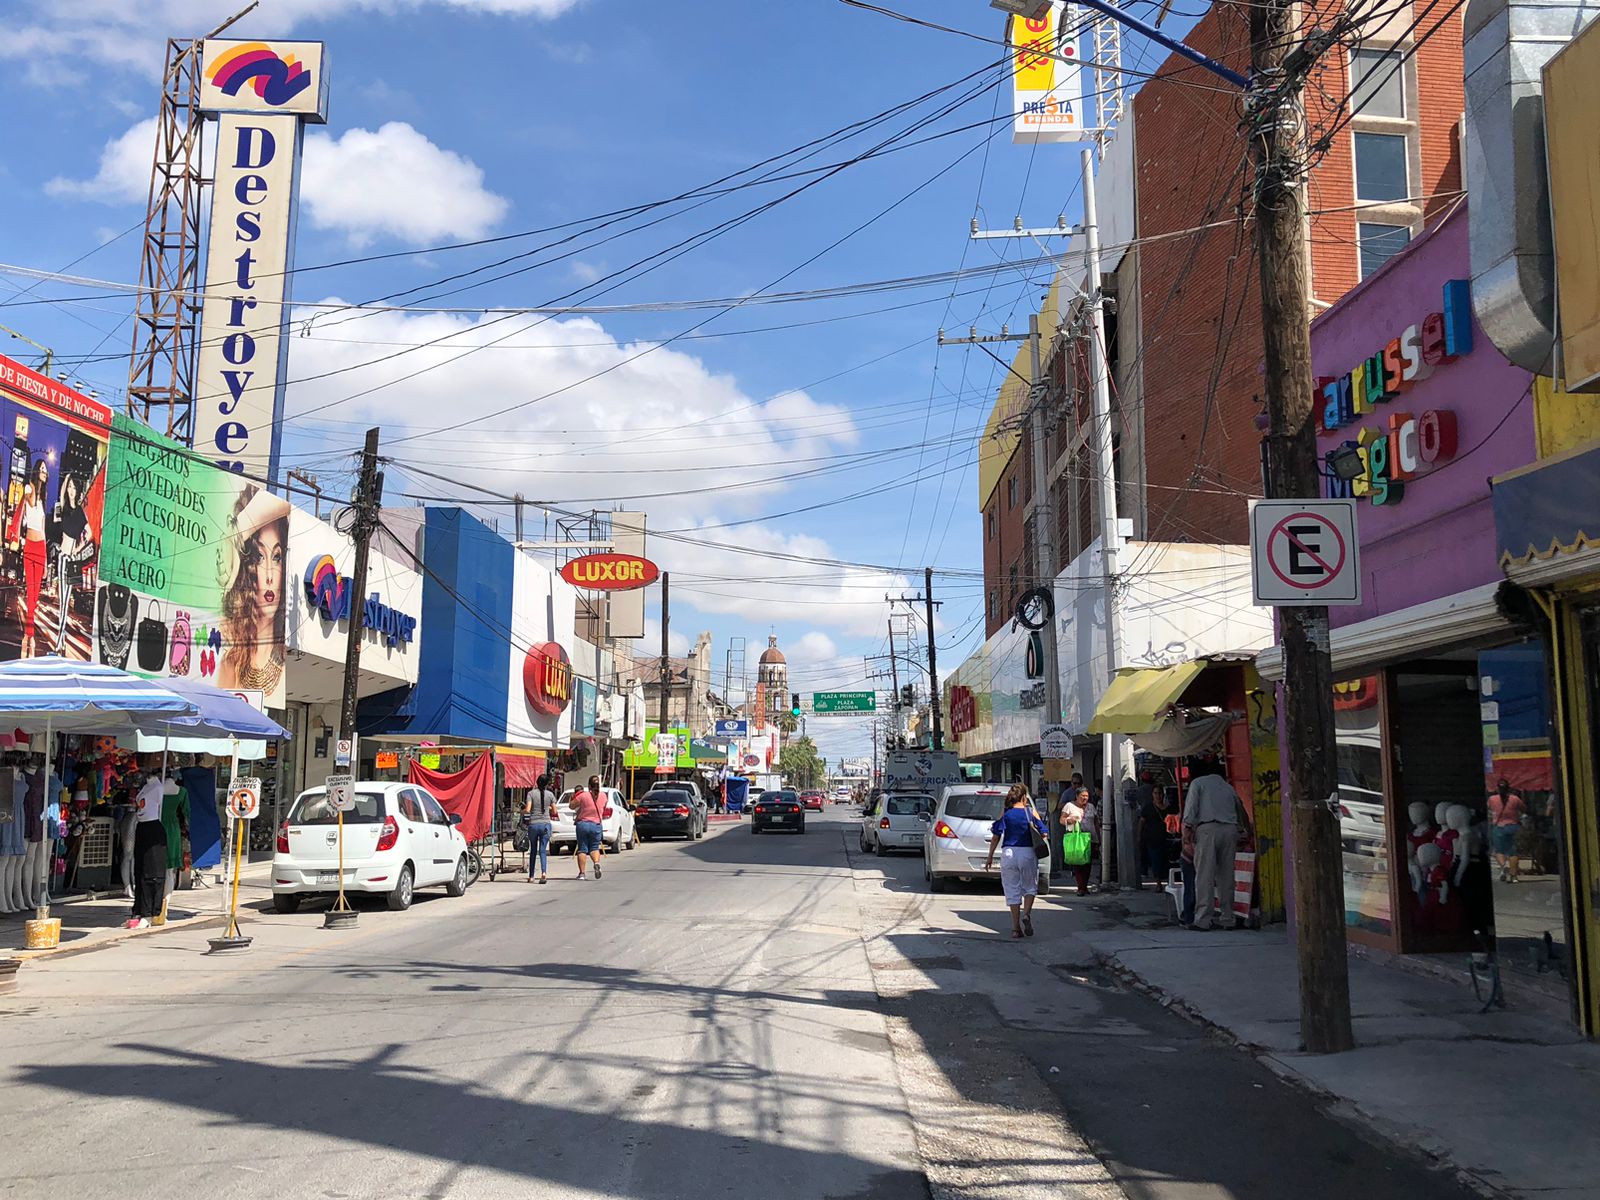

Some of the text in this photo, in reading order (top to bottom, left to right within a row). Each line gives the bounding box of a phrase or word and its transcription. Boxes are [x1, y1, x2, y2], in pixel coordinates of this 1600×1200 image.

[1028, 115, 1070, 123] PRENDA
[1313, 279, 1473, 436] arrussel
[0, 363, 14, 383] DE
[16, 372, 48, 400] FIESTA
[50, 388, 58, 403] Y
[58, 392, 72, 410] DE
[128, 429, 191, 478] REGALOS
[126, 460, 206, 515] NOVEDADES
[119, 523, 162, 559] PLATA
[122, 493, 207, 545] ACCESORIOS
[573, 560, 645, 582] LUXOR
[1288, 525, 1324, 574] E
[116, 557, 166, 590] ACERO
[756, 684, 765, 729] LUXOR
